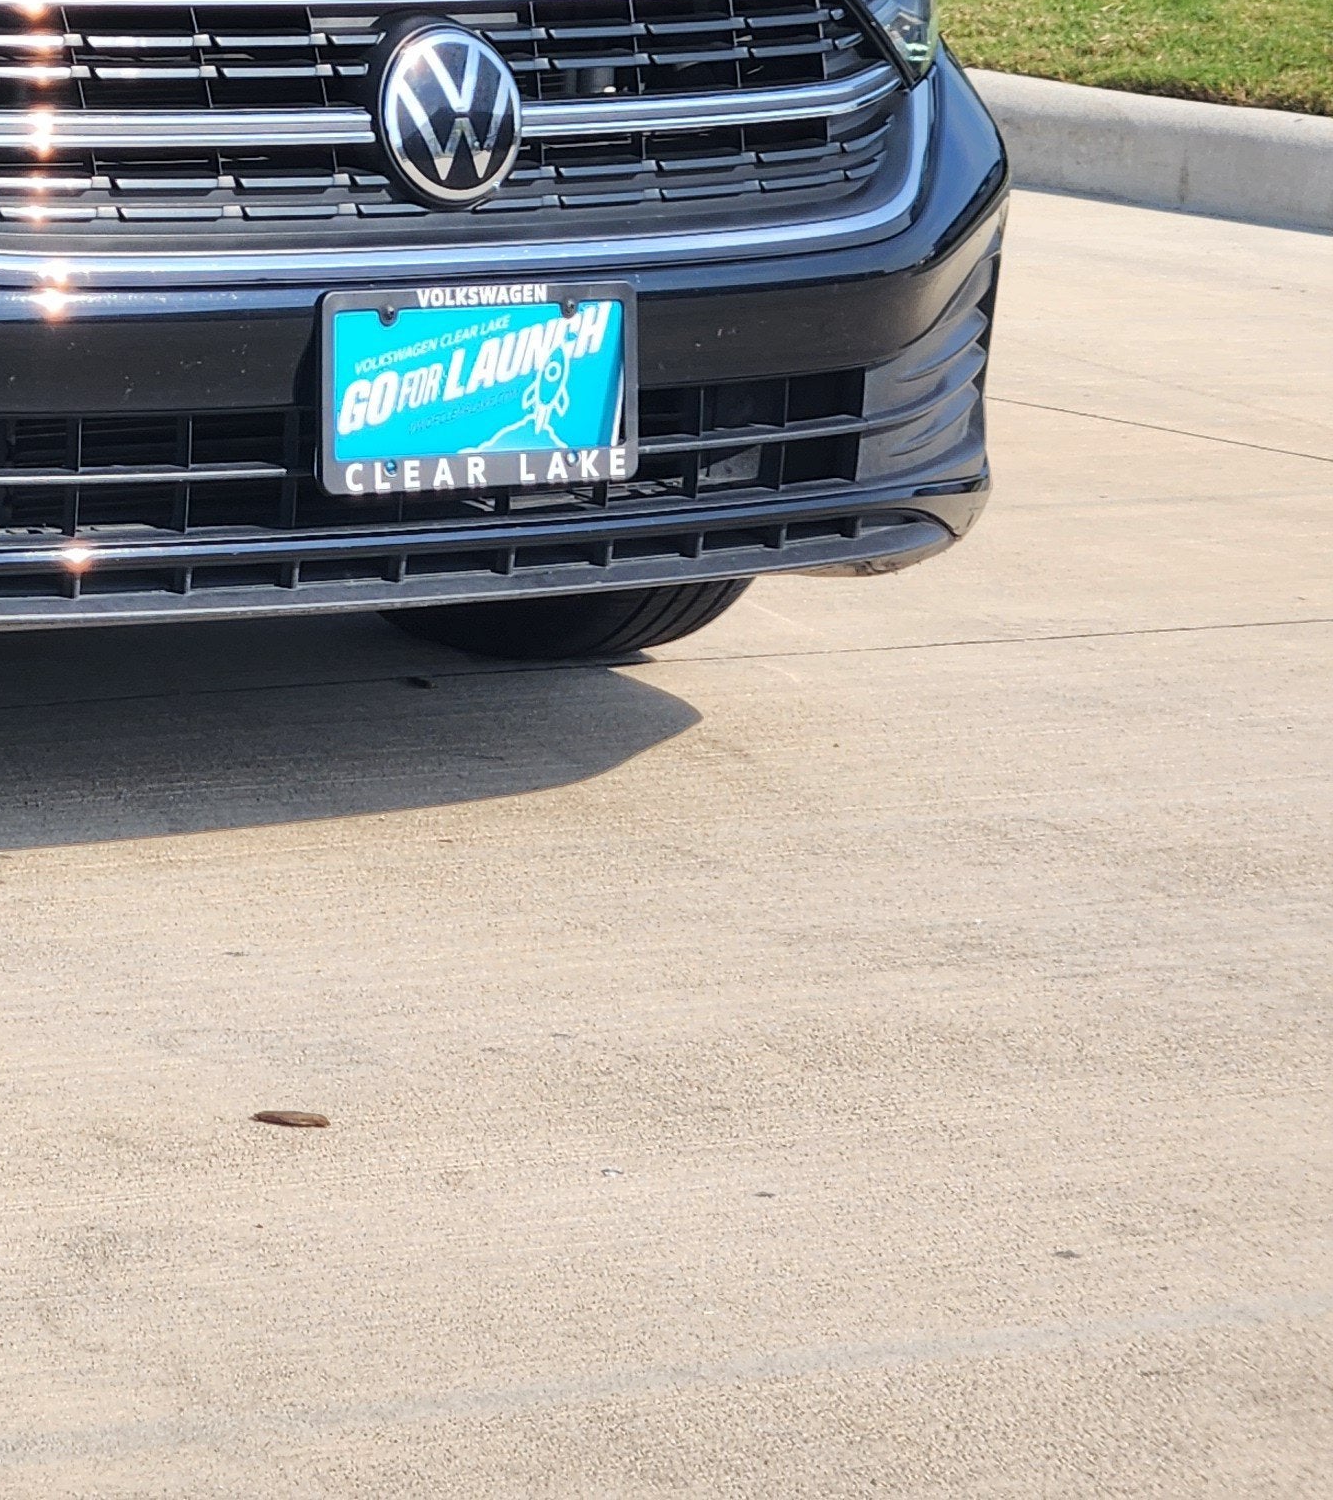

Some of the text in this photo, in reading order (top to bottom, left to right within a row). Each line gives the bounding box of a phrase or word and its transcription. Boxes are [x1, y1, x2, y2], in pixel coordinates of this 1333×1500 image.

[386, 28, 521, 201] VW
[417, 284, 548, 308] VOLKSWAGEN
[337, 370, 400, 436] GO
[396, 362, 444, 413] FOR
[442, 300, 612, 402] LAUNCH
[354, 314, 511, 375] VOLKSWAGEN CLEAR LAKE
[345, 449, 626, 492] CLEAR LAKE
